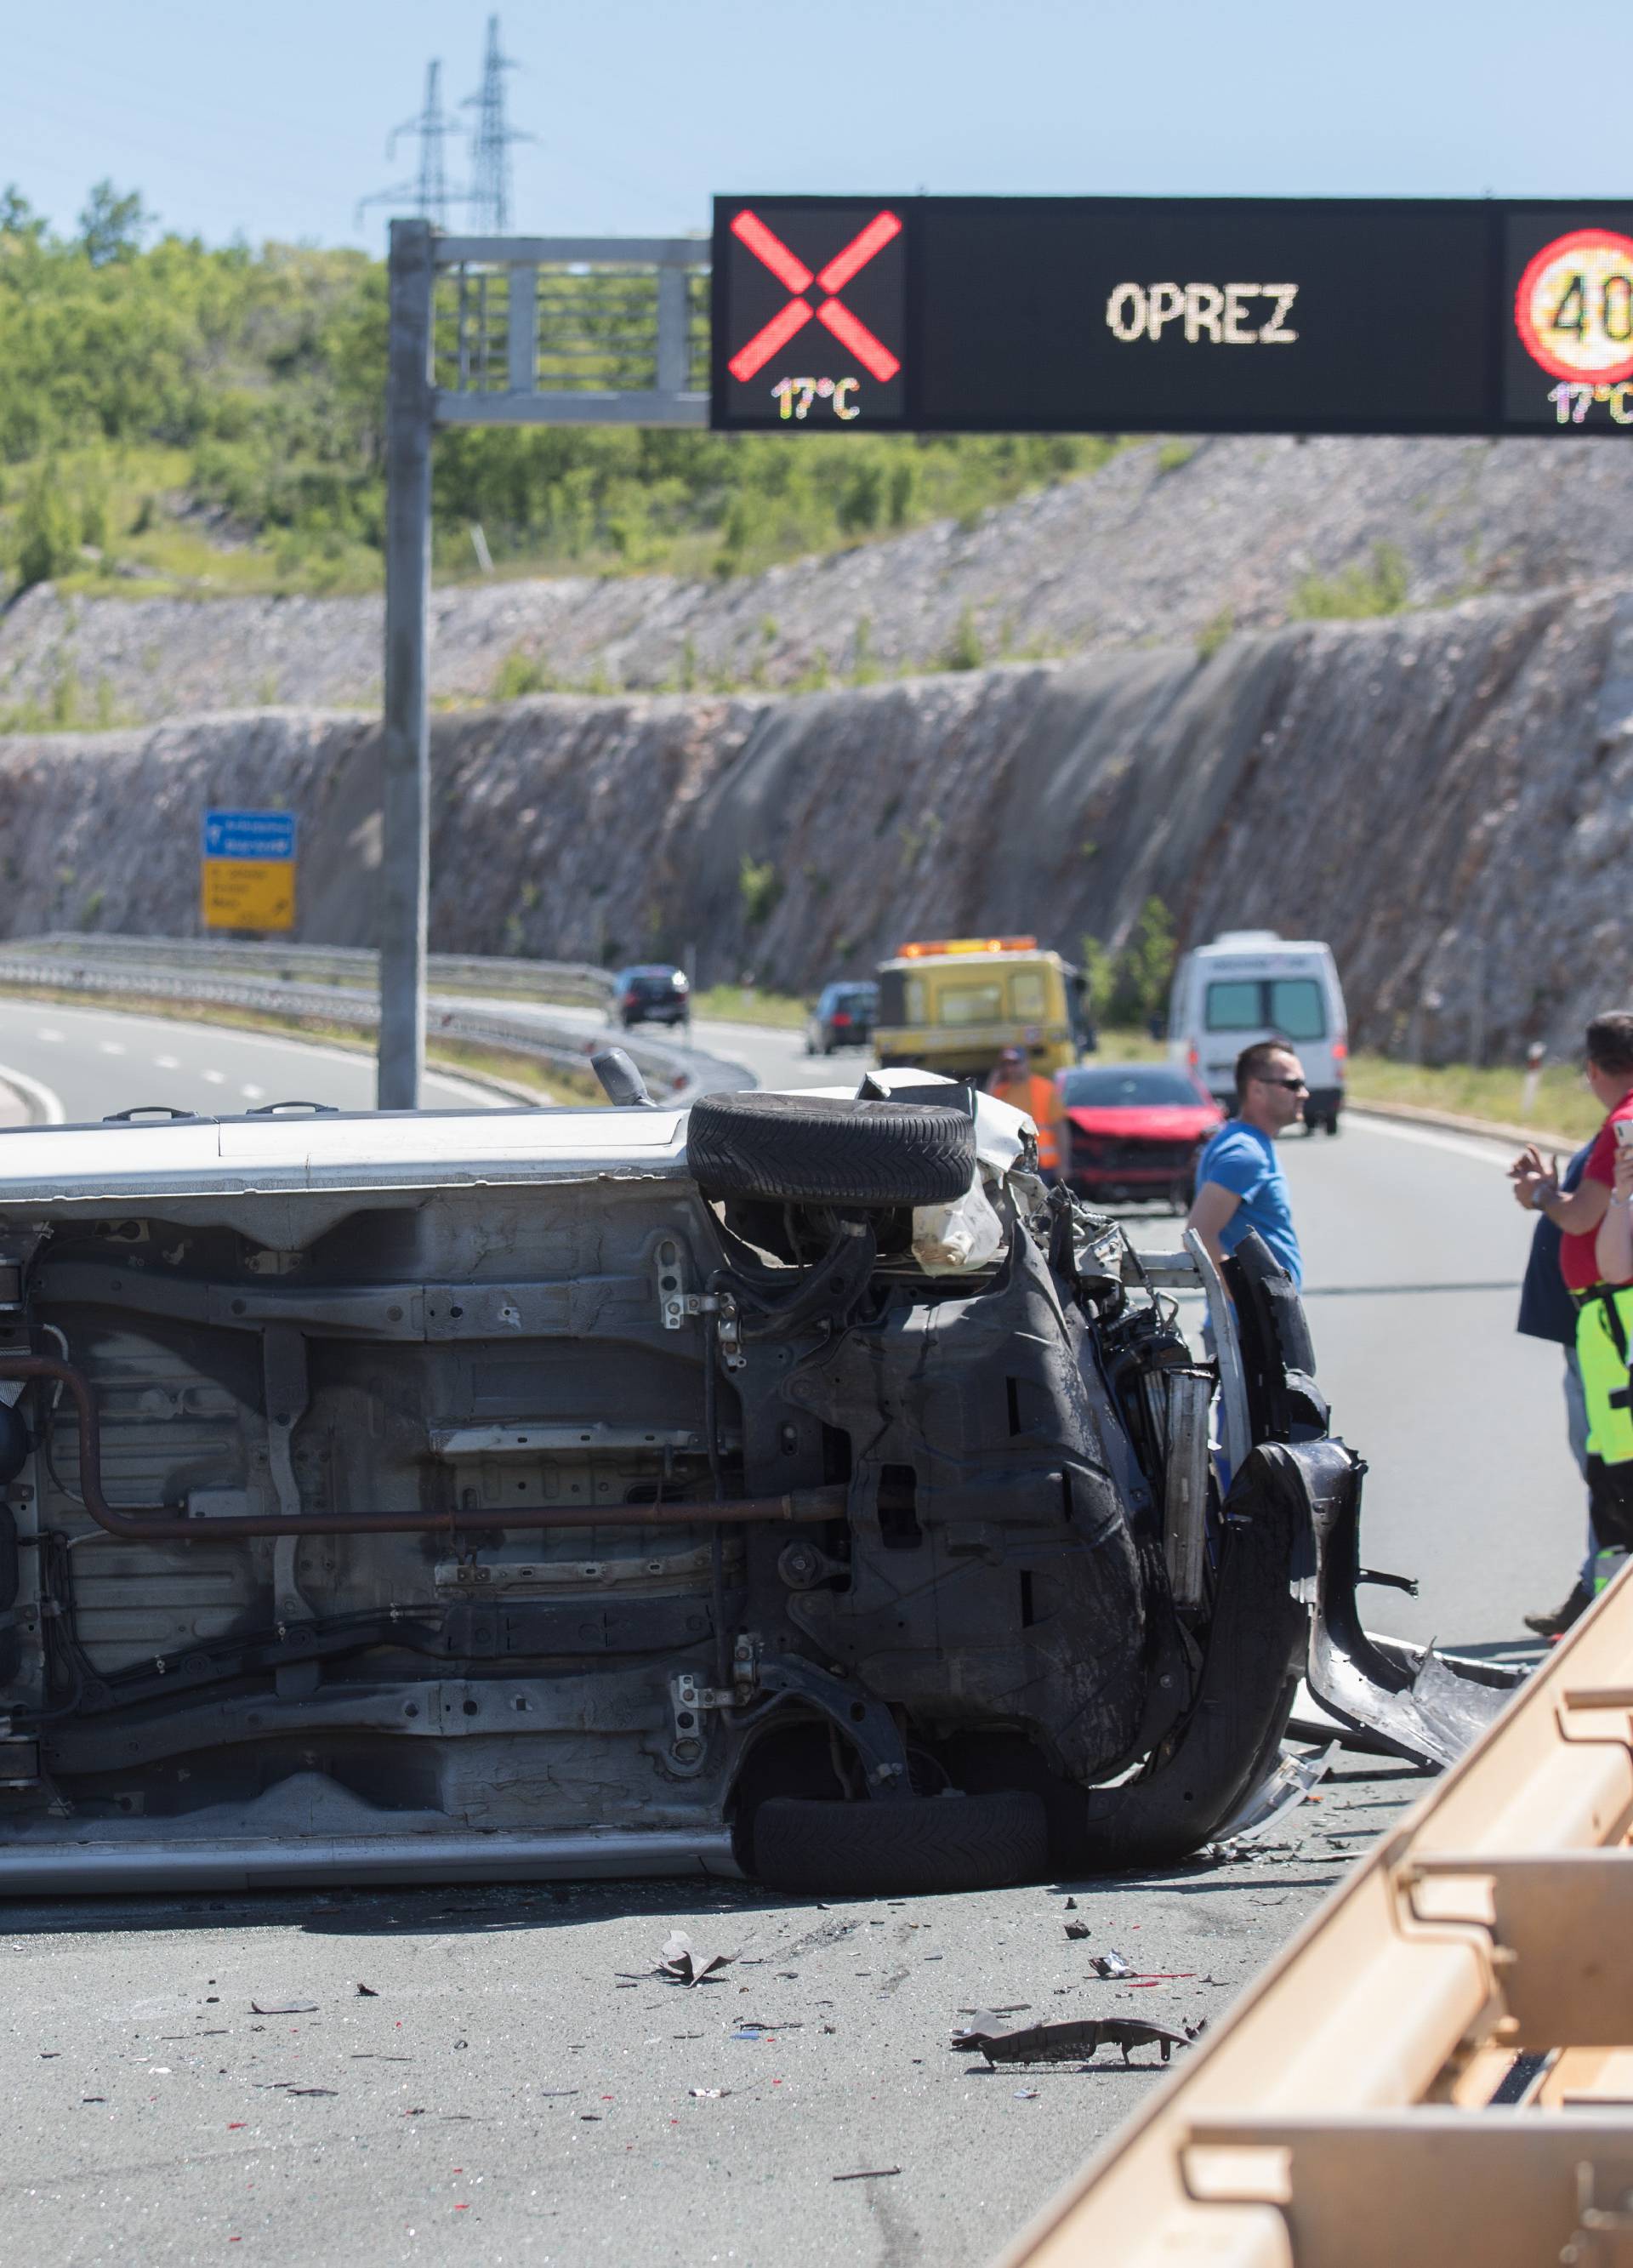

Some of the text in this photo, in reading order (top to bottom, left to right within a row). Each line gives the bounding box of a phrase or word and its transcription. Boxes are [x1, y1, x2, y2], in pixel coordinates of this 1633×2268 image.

[1106, 282, 1300, 344] OPREZ
[1551, 272, 1633, 343] 40
[771, 377, 861, 419] 17°C
